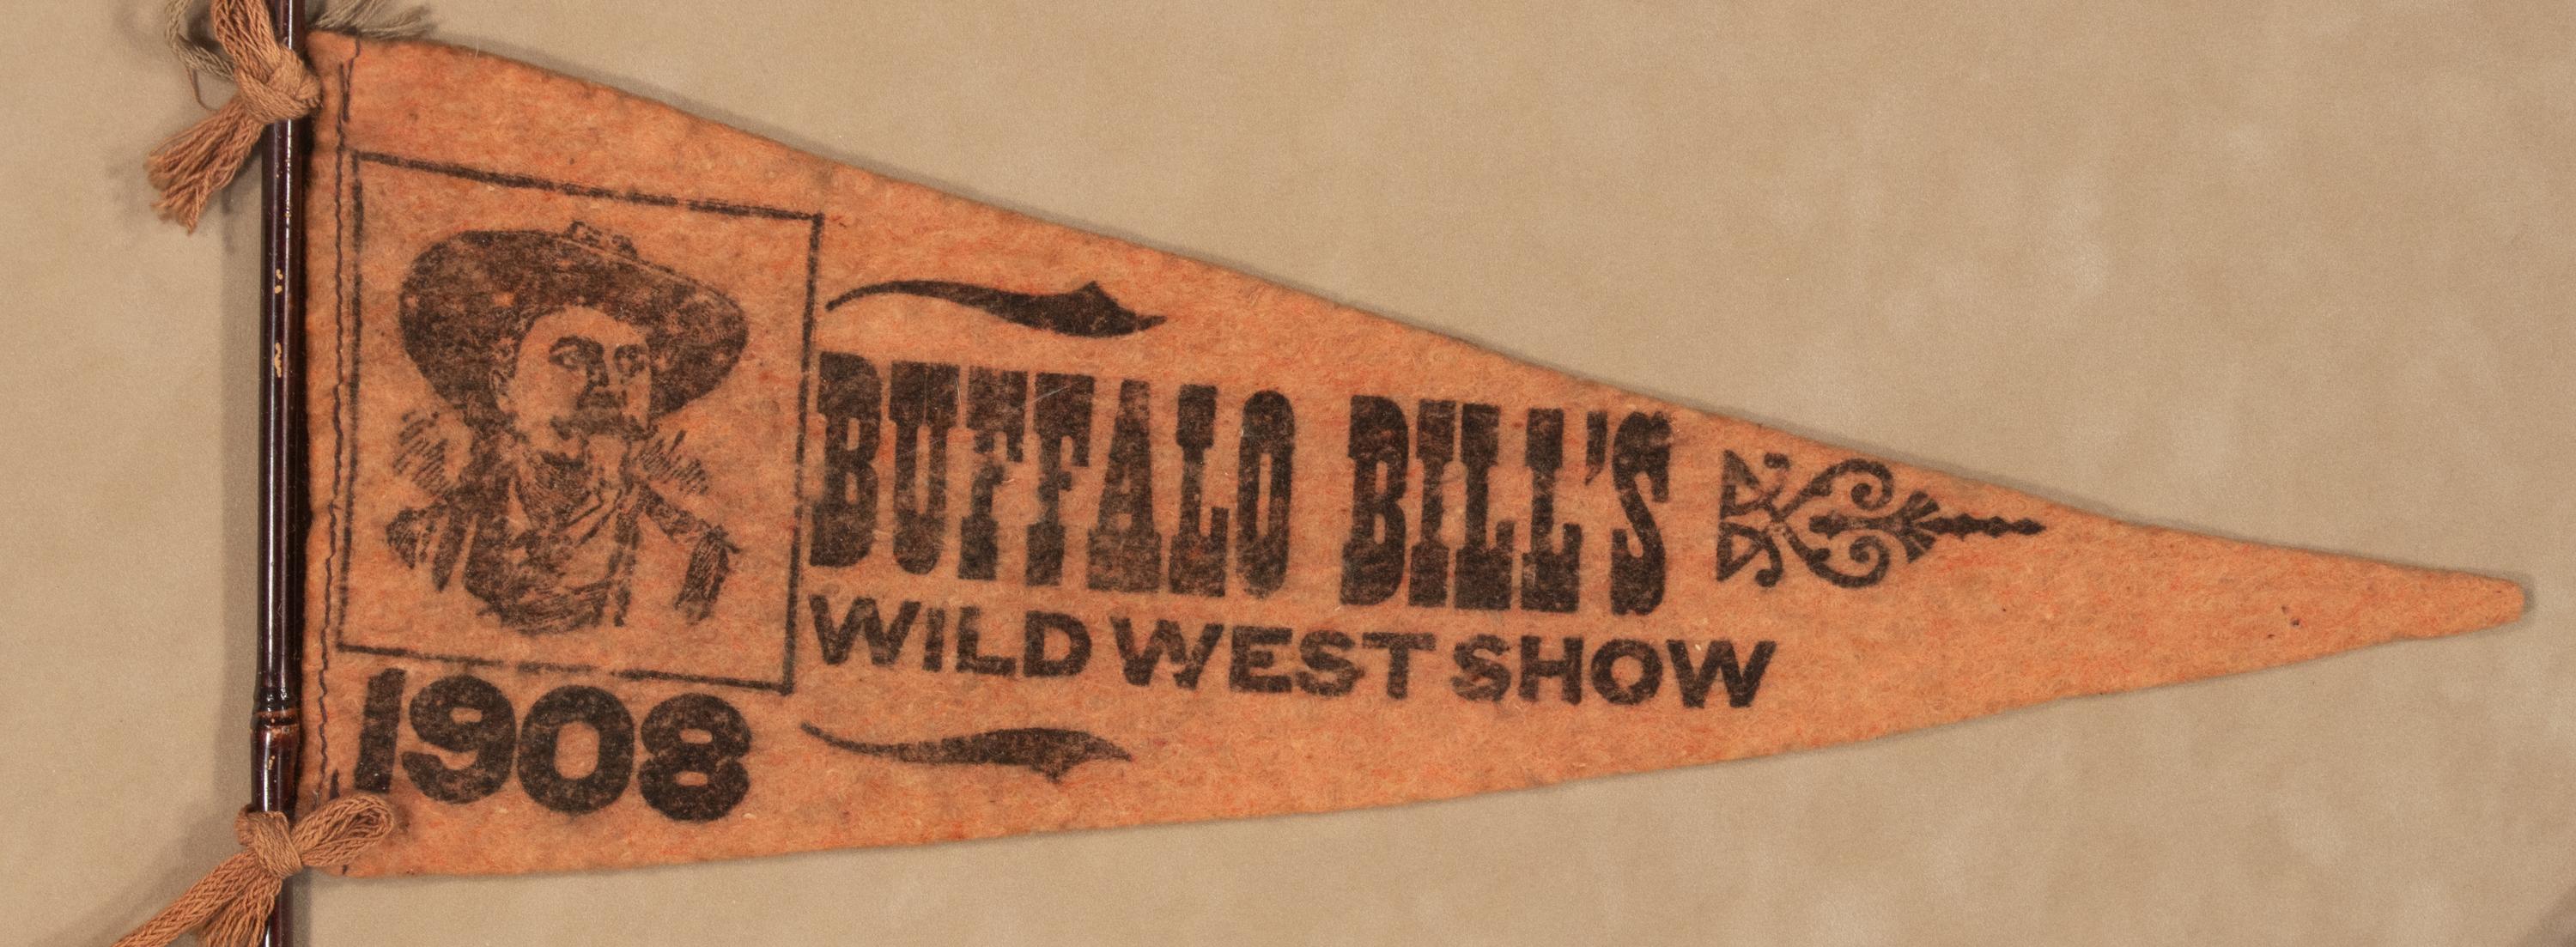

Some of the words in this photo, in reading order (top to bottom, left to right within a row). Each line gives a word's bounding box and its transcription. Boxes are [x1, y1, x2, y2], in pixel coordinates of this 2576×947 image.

[809, 350, 1297, 599] BUFFALO
[1340, 394, 1673, 616] BILL'S
[808, 593, 1093, 679] WILD
[1109, 615, 1437, 701] WEST
[1449, 633, 1777, 709] SHOW
[353, 667, 753, 823] 1908
